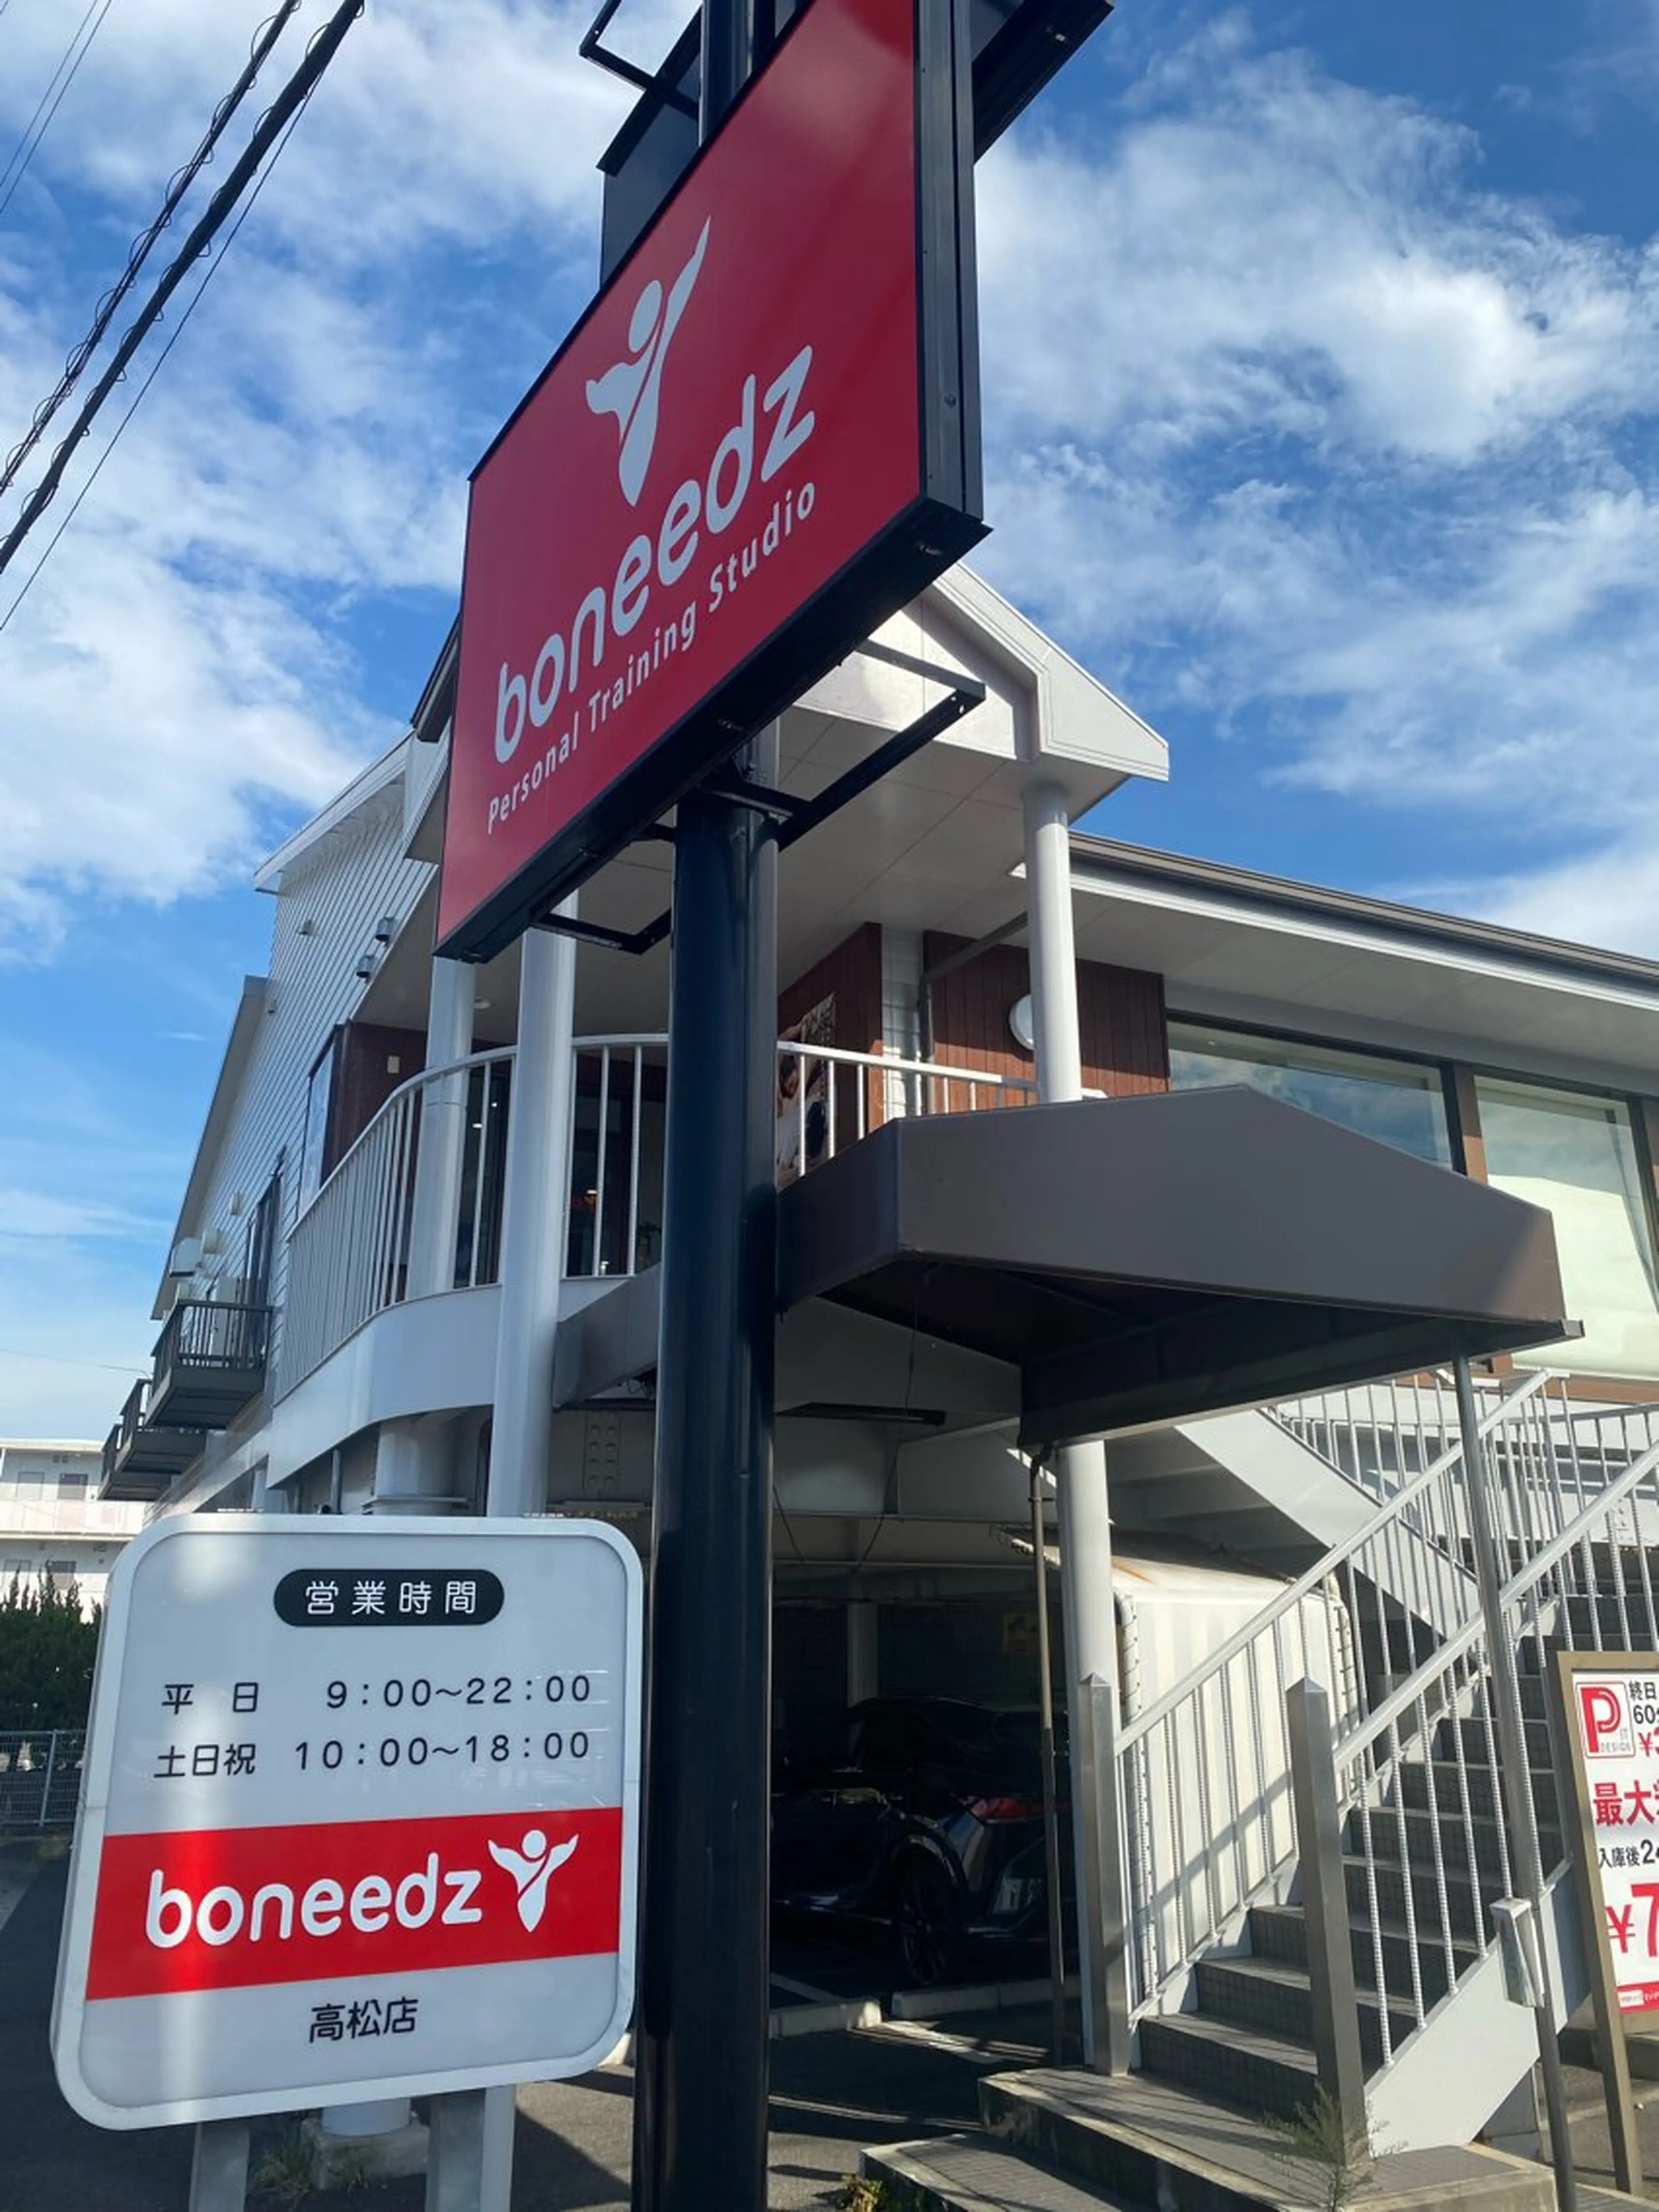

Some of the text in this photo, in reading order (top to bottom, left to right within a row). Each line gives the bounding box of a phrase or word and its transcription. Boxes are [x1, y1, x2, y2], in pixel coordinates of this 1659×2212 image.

[494, 344, 815, 764] boneedz
[488, 483, 814, 835] Personal Training Studio
[305, 1580, 478, 1616] 営業時間
[1633, 1705, 1659, 1724] 60
[154, 1744, 256, 1778] 土日祝
[1593, 1779, 1659, 1827] 最大
[1599, 1839, 1659, 1869] 入庫後2
[146, 1853, 483, 1948] boneedz
[309, 1996, 419, 2043] 高松店
